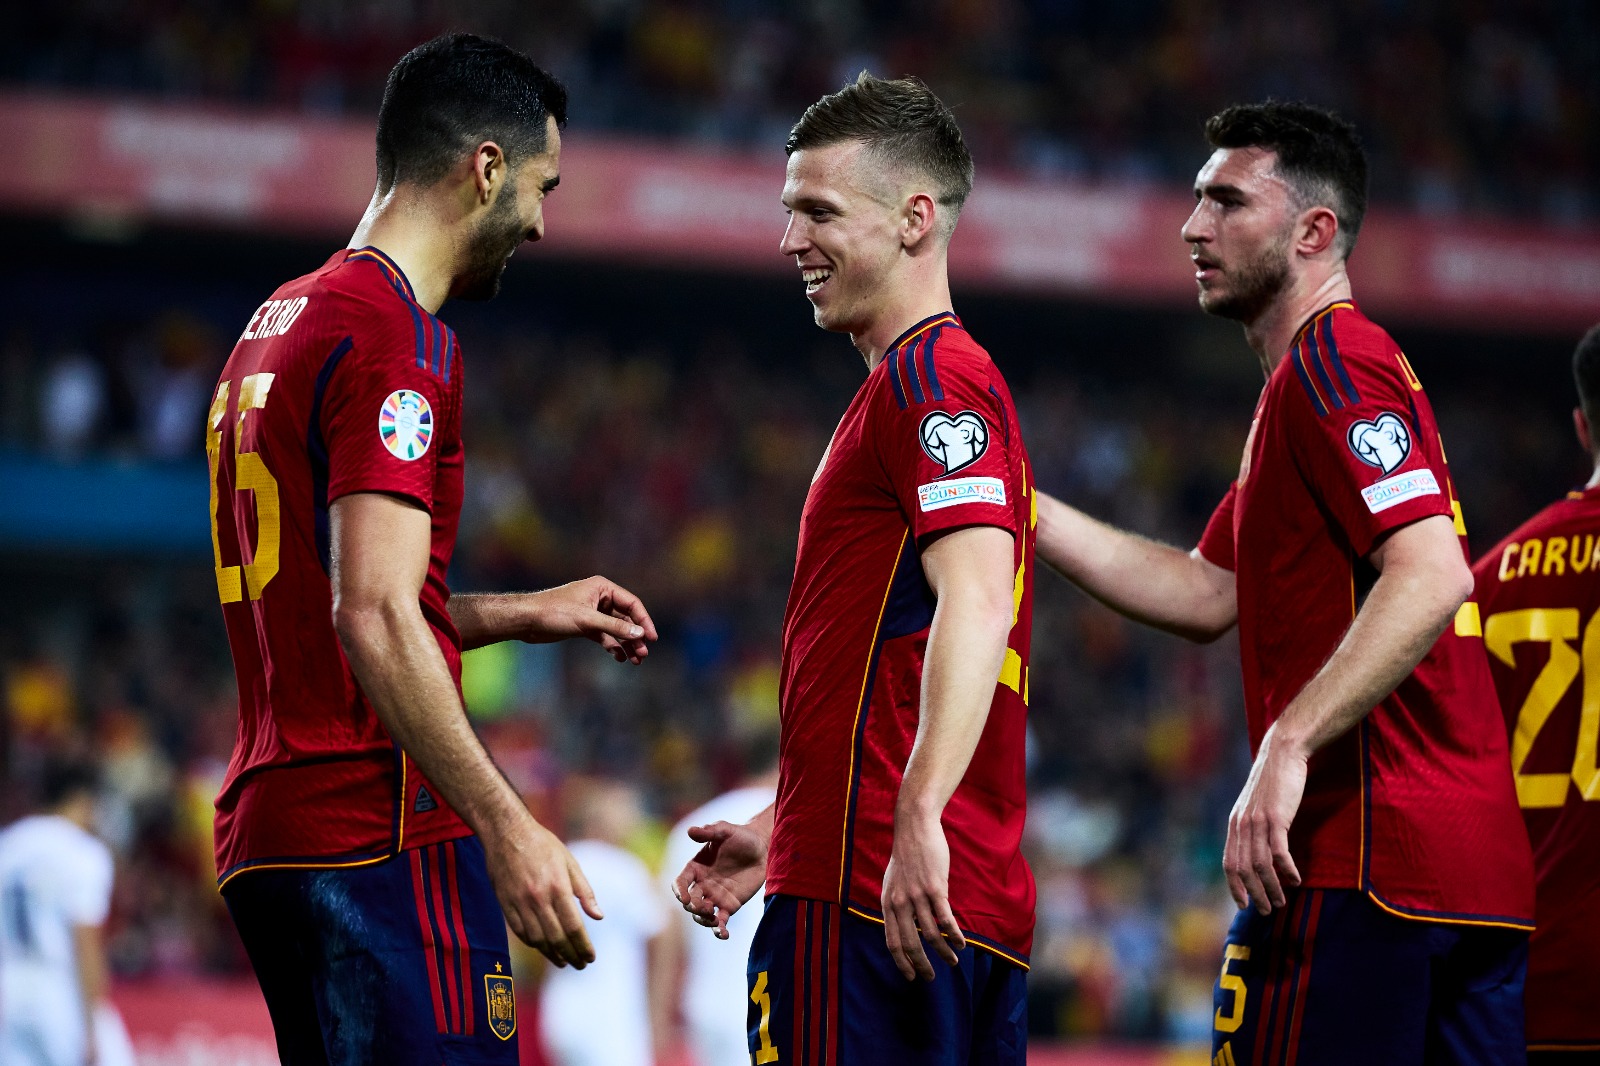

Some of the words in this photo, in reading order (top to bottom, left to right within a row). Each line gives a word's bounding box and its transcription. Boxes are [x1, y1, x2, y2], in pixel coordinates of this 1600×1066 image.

[919, 484, 939, 494] UEFA
[920, 485, 1003, 503] FOUNDATION
[1367, 477, 1435, 503] FOUNDATION
